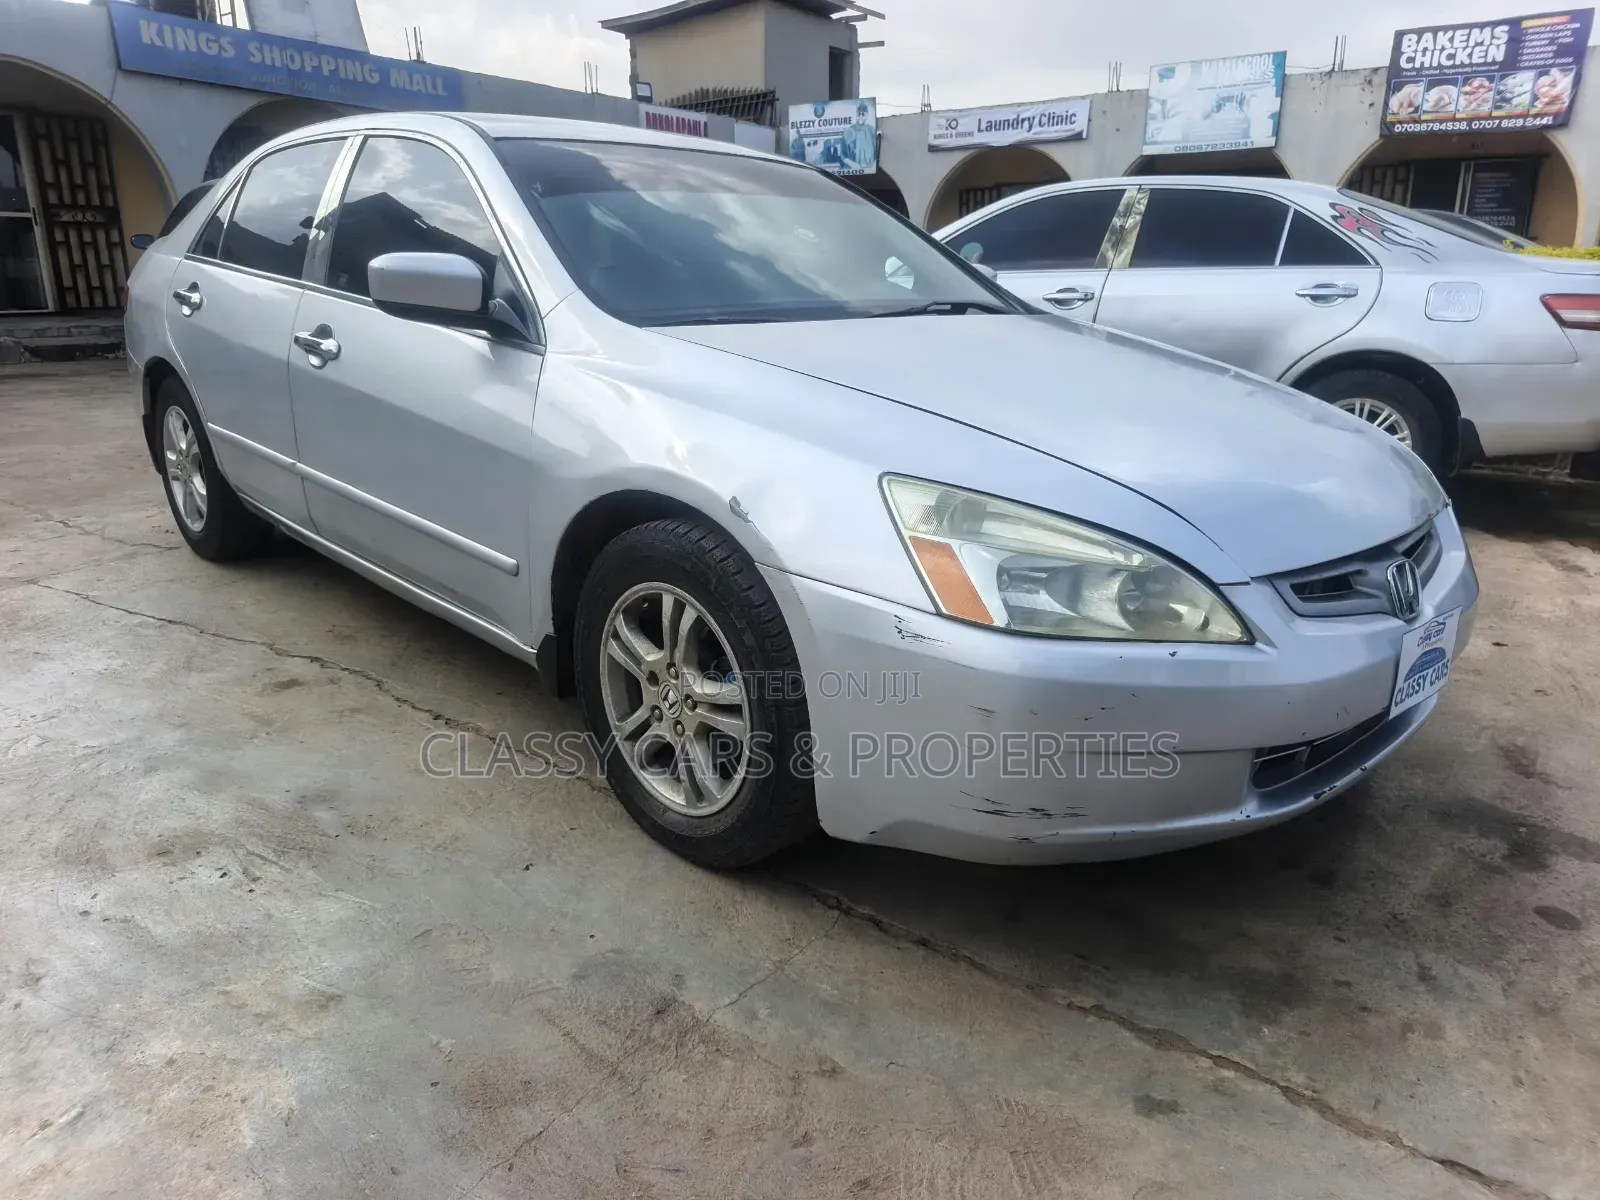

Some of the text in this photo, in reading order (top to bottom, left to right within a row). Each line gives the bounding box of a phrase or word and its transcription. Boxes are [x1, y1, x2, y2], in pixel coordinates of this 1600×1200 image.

[1401, 25, 1510, 53] BAKEMS
[139, 19, 236, 58] KINGS
[249, 41, 380, 84] SHOPPING
[389, 68, 448, 97] MALL
[1400, 44, 1506, 69] CHICKEN
[790, 120, 815, 130] BLEZZY
[818, 116, 853, 127] COUTURE
[977, 110, 1078, 133] Laundry Clinic
[1471, 119, 1500, 129] 0707
[1524, 116, 1554, 126] 2441
[1394, 671, 1430, 708] CLASSY
[1430, 658, 1450, 687] CARS
